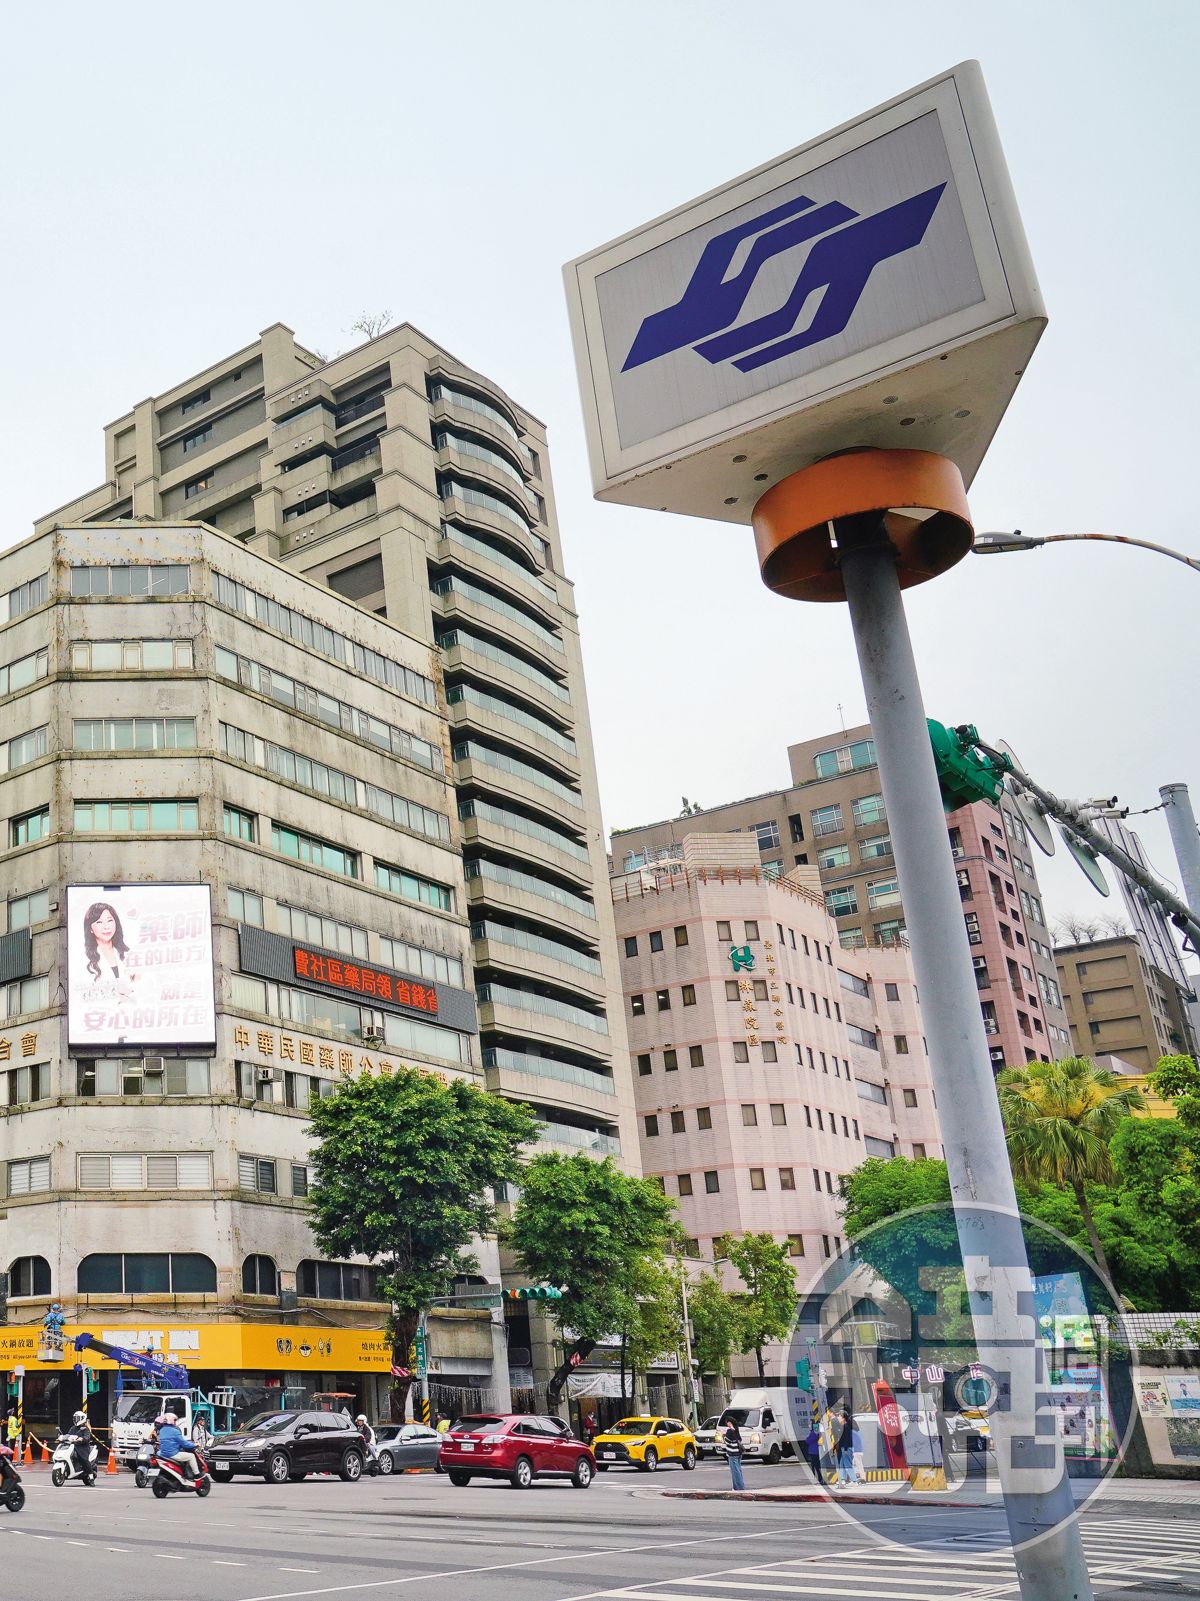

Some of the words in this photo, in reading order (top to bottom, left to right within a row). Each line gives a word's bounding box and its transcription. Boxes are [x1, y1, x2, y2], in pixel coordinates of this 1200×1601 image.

[138, 911, 203, 944] 藥師
[125, 945, 204, 968] 在的地方
[83, 1005, 208, 1032] 安心的所在
